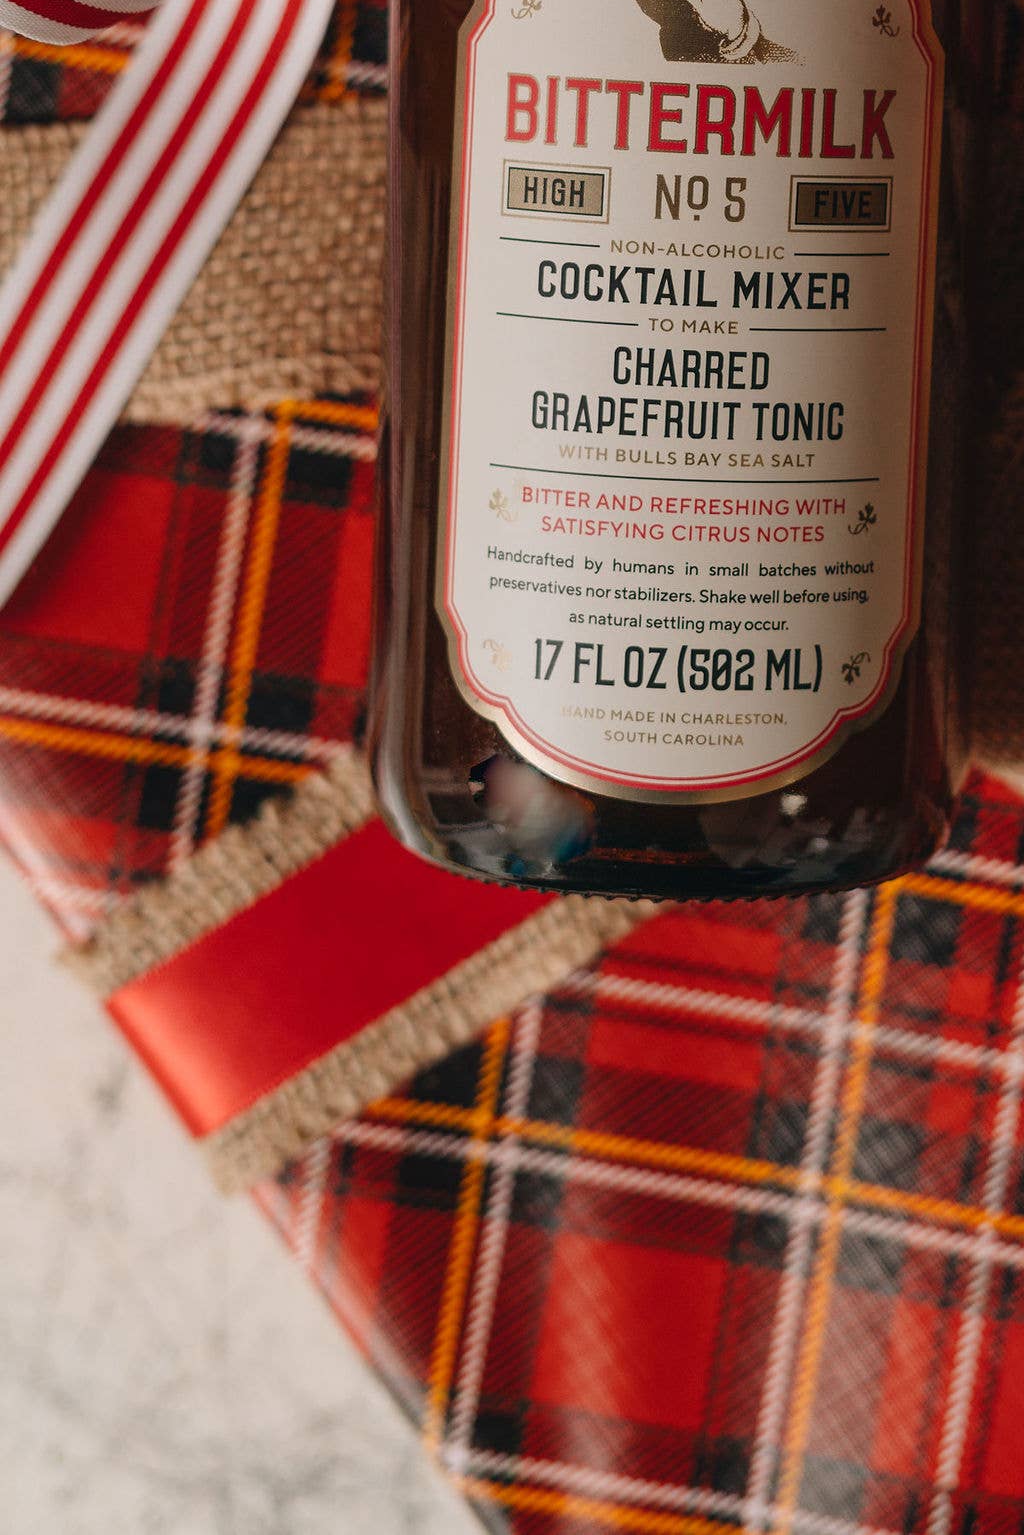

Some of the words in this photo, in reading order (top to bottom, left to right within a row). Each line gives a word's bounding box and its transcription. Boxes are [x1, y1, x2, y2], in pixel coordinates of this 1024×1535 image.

[505, 72, 897, 159] BITTERMILK
[523, 176, 586, 208] HIGH
[724, 177, 748, 222] 5
[814, 189, 871, 219] FIVE
[610, 239, 786, 261] NON-ALCOHOLIC
[538, 260, 718, 308] COCKTAIL
[732, 271, 851, 310] MIXER
[648, 318, 674, 332] TO
[682, 319, 739, 335] MAKE
[613, 347, 770, 390] CHARRED
[531, 390, 741, 441] GRAPEFRUIT
[751, 402, 844, 441] TONIC
[558, 445, 608, 461] WITH
[615, 449, 677, 465] BULLS
[684, 451, 721, 466] BAY
[728, 452, 764, 467] SEA
[771, 452, 816, 468] SALT
[522, 486, 590, 508] BITTER
[596, 493, 644, 512] AND
[650, 496, 789, 516] REFRESHING
[796, 498, 846, 515] WITH
[541, 516, 665, 540] SATISFYING
[671, 524, 750, 543] CITRUS
[757, 526, 825, 543] NOTES
[487, 546, 575, 569] Handcrafted
[584, 556, 602, 574] by
[613, 559, 674, 576] humans
[685, 562, 699, 576] in
[709, 562, 749, 577] small
[759, 561, 817, 578] batches
[824, 560, 874, 576] without
[489, 574, 582, 598] preservatives
[585, 585, 611, 599] nor
[614, 586, 695, 603] stabilizers.
[699, 589, 747, 604] Shake
[749, 589, 780, 604] well
[783, 588, 831, 604] before
[569, 611, 585, 625] as
[589, 610, 643, 629] natural
[646, 614, 705, 632] settling
[708, 618, 742, 634] may
[744, 620, 789, 632] occur.
[534, 637, 563, 681] 17
[573, 642, 615, 687] FL
[624, 645, 668, 689] OZ
[677, 646, 755, 693] (502
[765, 645, 822, 692] ML)
[562, 706, 606, 720] HAND
[611, 708, 656, 723] MADE
[660, 711, 678, 723] IN
[681, 712, 788, 726] CHARLESTON,
[603, 729, 657, 745] SOUTH
[663, 732, 744, 747] CAROLINA
